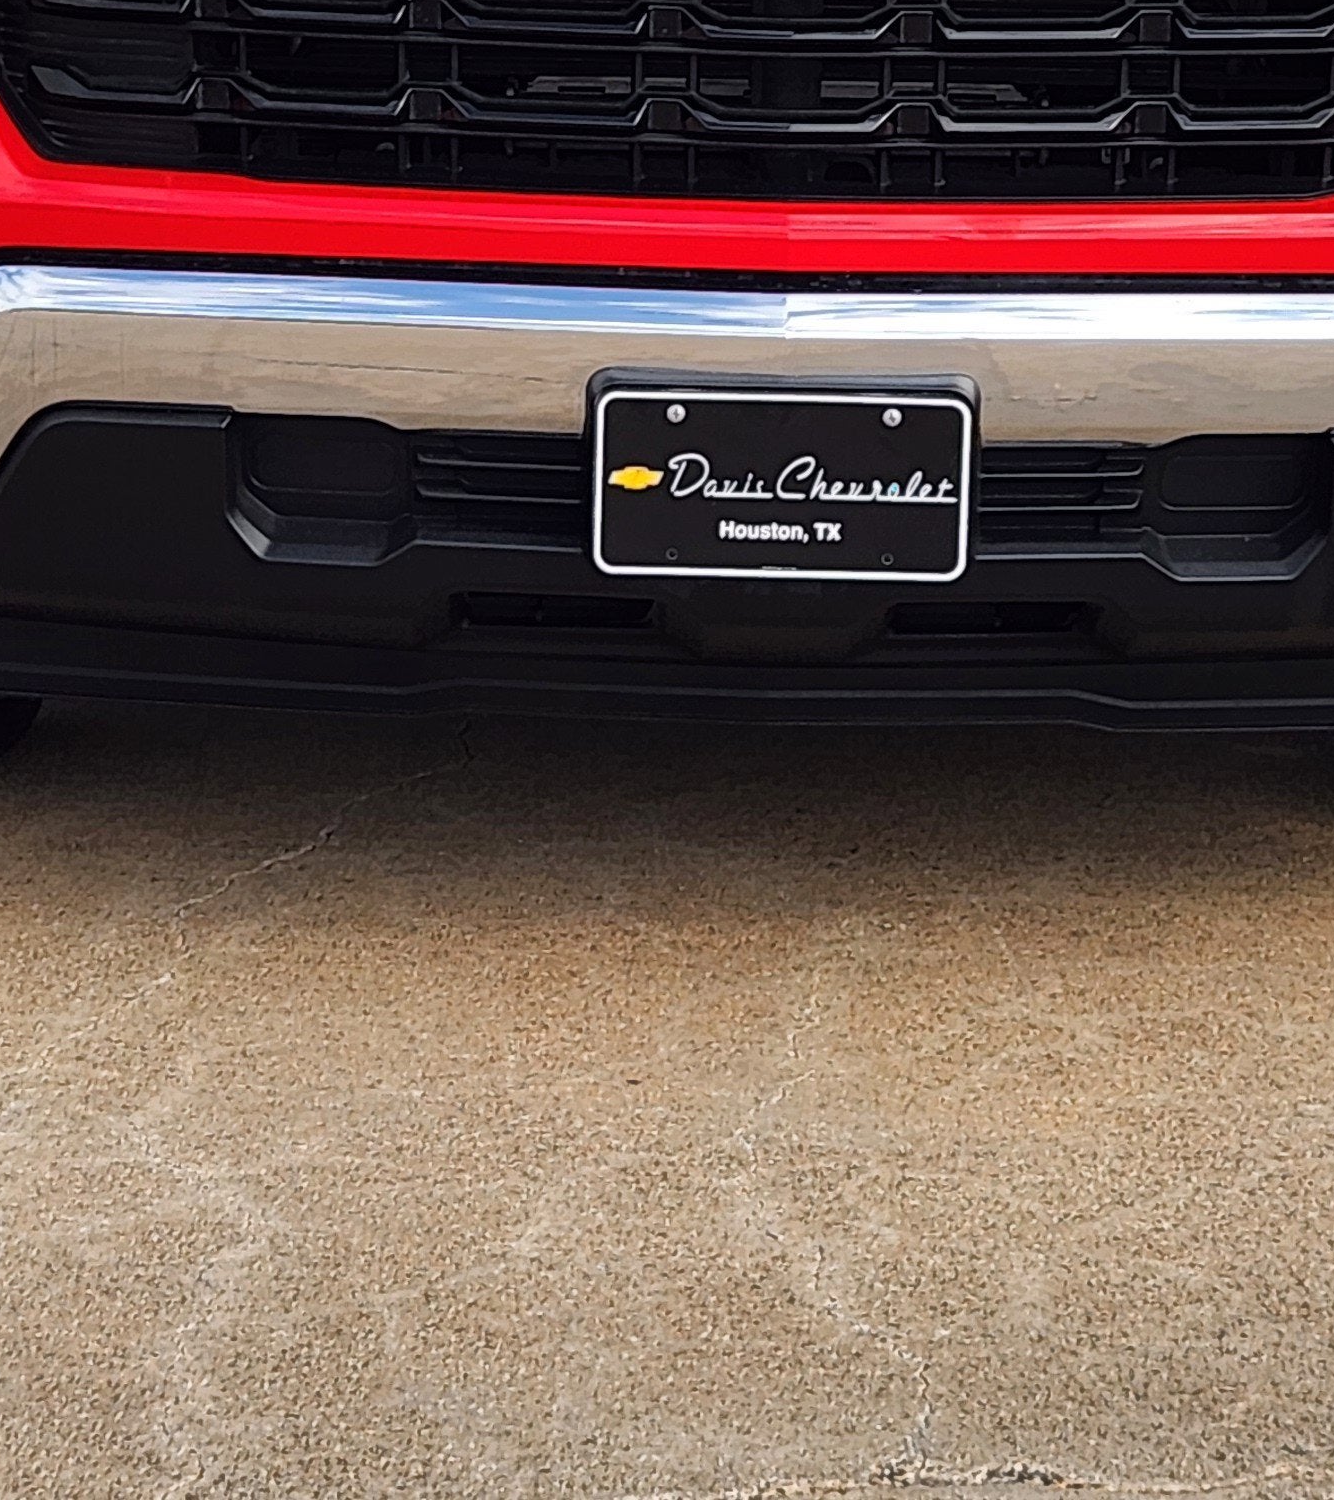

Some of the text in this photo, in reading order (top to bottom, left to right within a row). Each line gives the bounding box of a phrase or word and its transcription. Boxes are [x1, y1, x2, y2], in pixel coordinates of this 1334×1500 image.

[668, 452, 959, 504] Davis Chevrolet
[718, 519, 842, 543] Houston, TX
